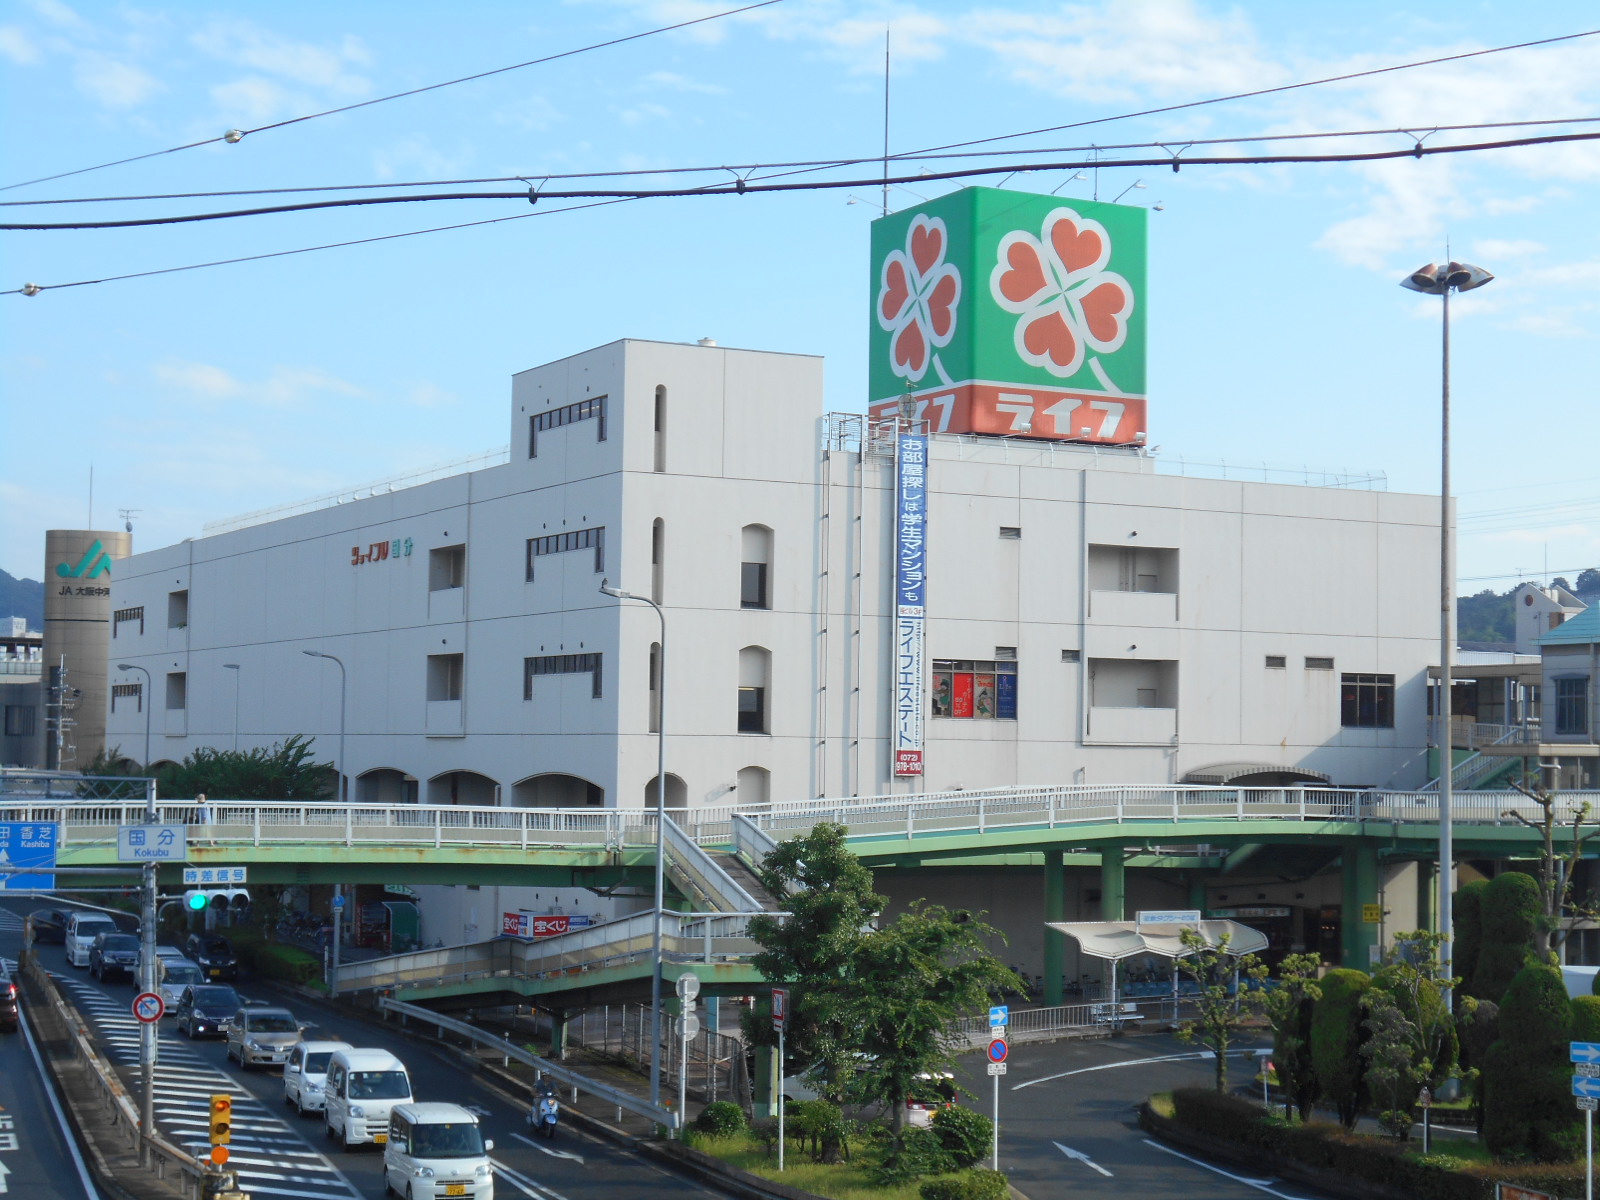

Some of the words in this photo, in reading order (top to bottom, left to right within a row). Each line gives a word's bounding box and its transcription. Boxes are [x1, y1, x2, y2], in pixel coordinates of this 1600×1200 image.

[996, 393, 1125, 438] ライフ
[898, 620, 914, 748] ライフエステート
[20, 827, 52, 839] 香芝
[129, 829, 176, 846] 国分
[134, 848, 169, 857] Kokubu
[185, 869, 245, 882] 時差信号
[504, 917, 518, 930] 宝くじ
[534, 921, 566, 932] 宝くじ
